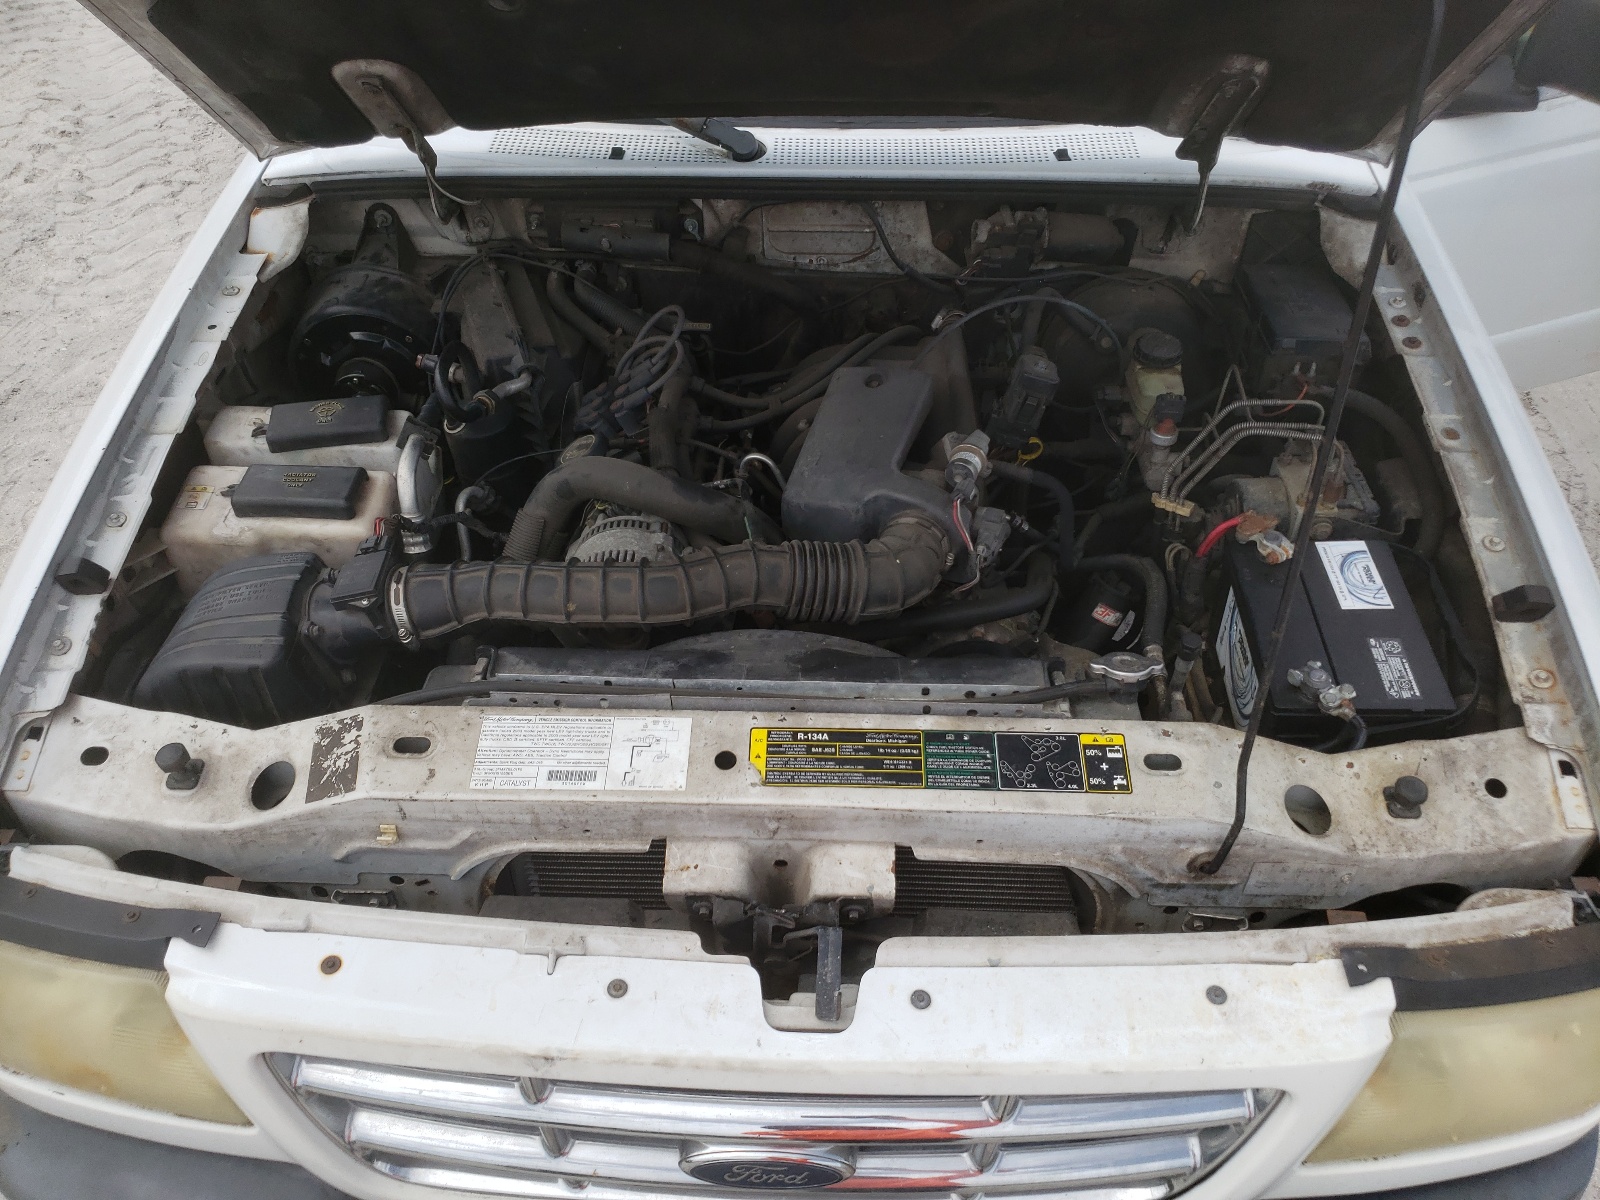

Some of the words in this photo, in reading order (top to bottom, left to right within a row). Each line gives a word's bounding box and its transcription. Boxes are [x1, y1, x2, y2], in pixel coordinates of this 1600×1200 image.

[797, 732, 829, 741] R-134A
[1089, 777, 1106, 785] 50%
[723, 1164, 809, 1185] Ford
